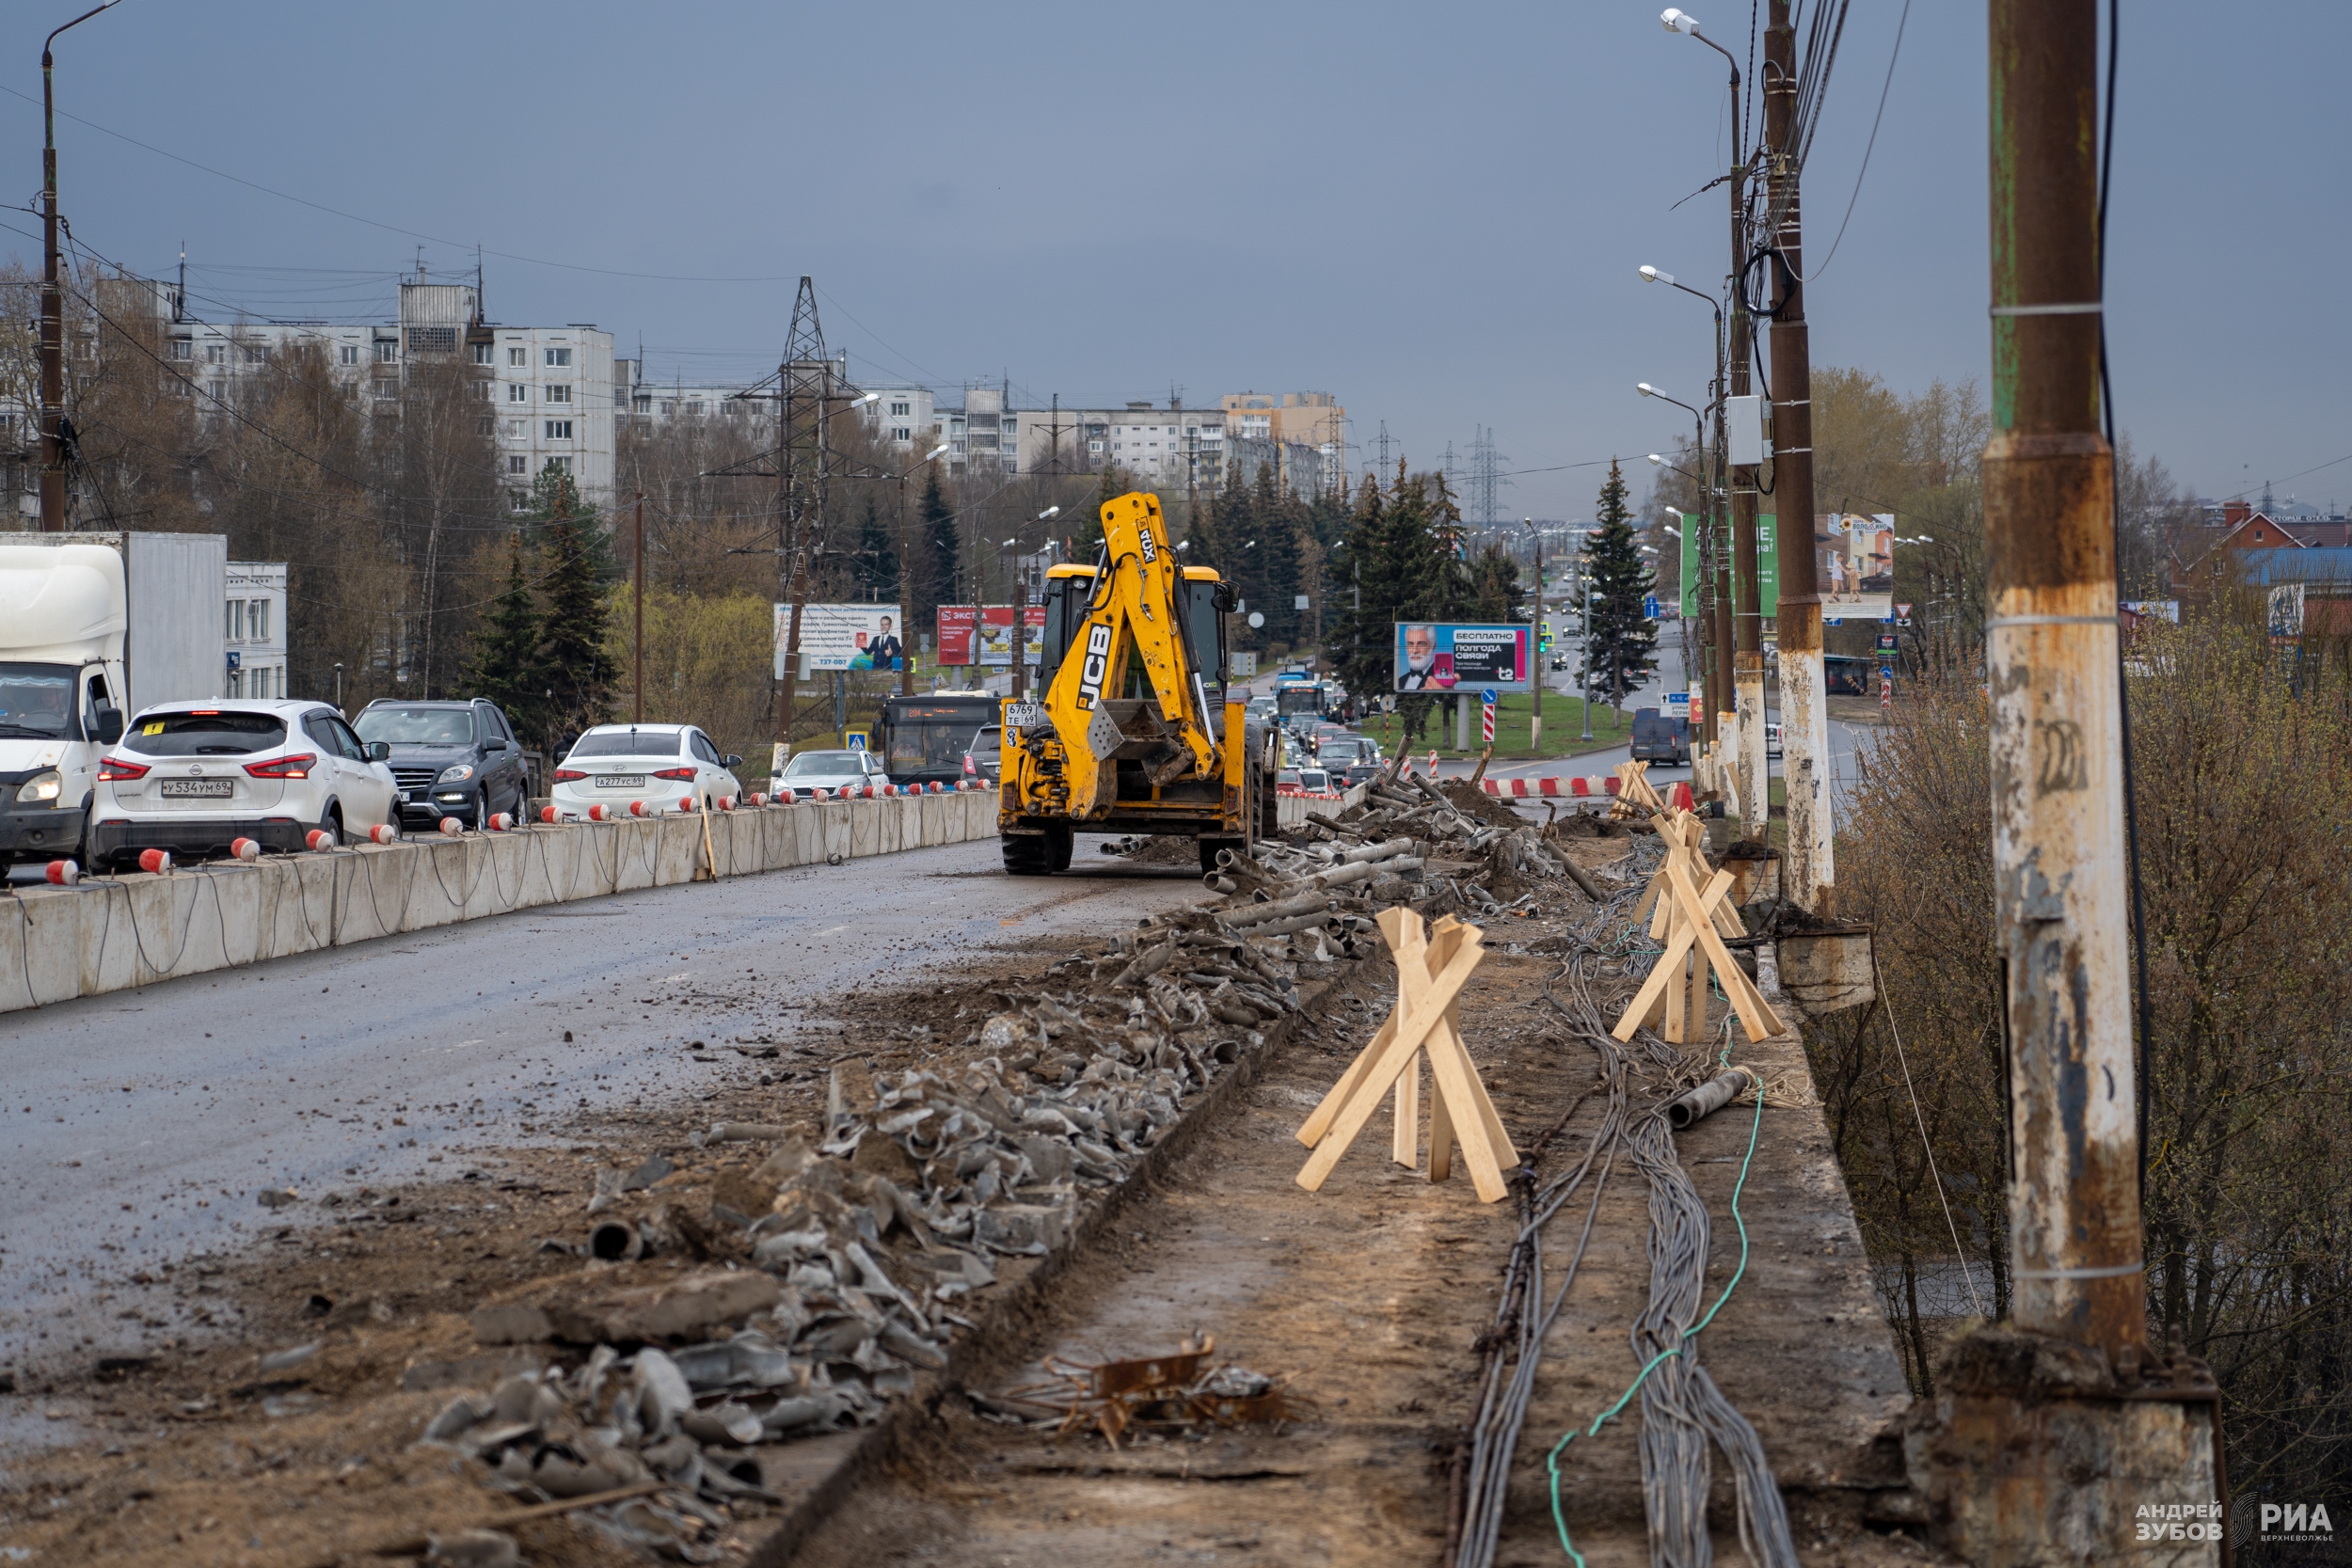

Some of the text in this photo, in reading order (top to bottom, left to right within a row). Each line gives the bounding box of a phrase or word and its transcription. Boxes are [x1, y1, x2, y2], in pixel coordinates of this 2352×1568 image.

[1140, 530, 1155, 562] 4CX
[1455, 644, 1502, 653] ПОЛГОДА
[1081, 626, 1110, 709] JCB
[1009, 705, 1033, 714] 6769
[167, 782, 228, 793] У534УМ 69
